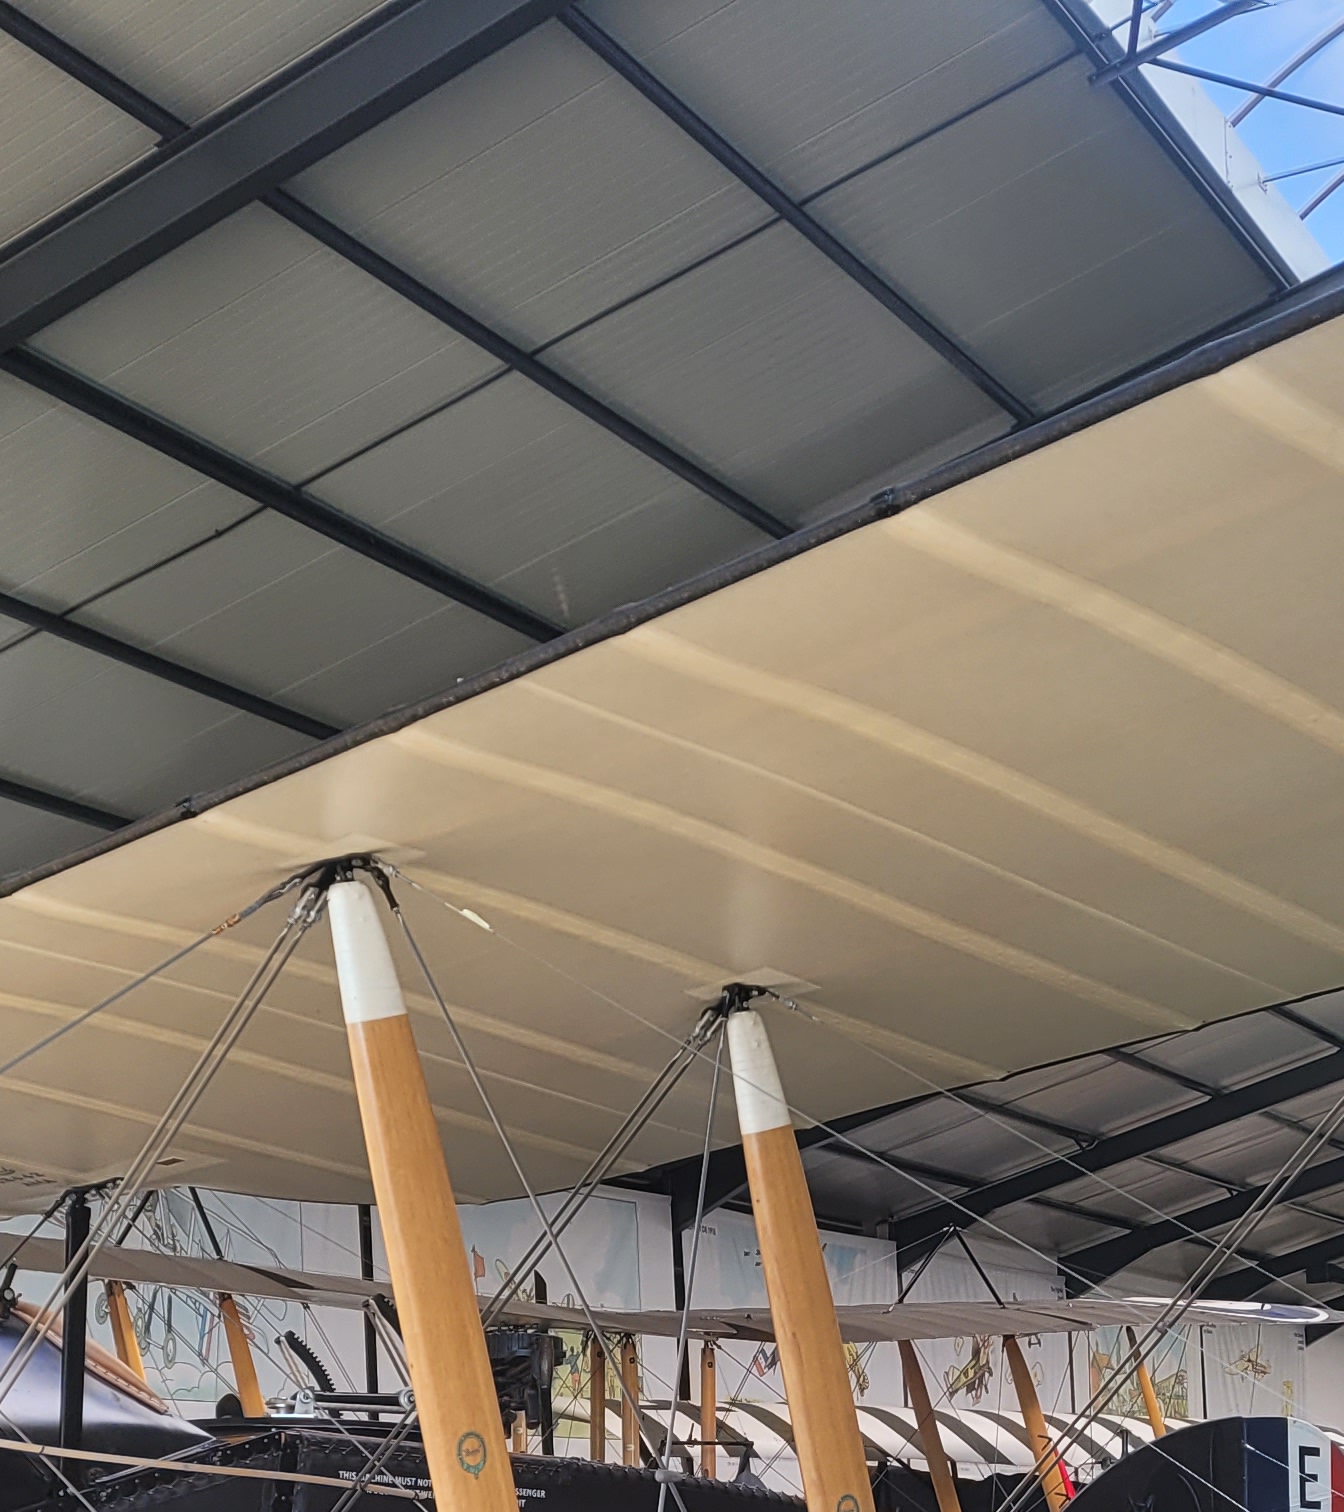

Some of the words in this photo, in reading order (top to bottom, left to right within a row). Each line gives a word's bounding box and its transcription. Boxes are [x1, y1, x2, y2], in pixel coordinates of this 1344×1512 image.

[338, 1470, 357, 1480] THIS
[395, 1475, 416, 1486] MUST
[417, 1478, 433, 1487] NOT
[1298, 1445, 1322, 1511] E
[514, 1487, 546, 1499] SSENGER
